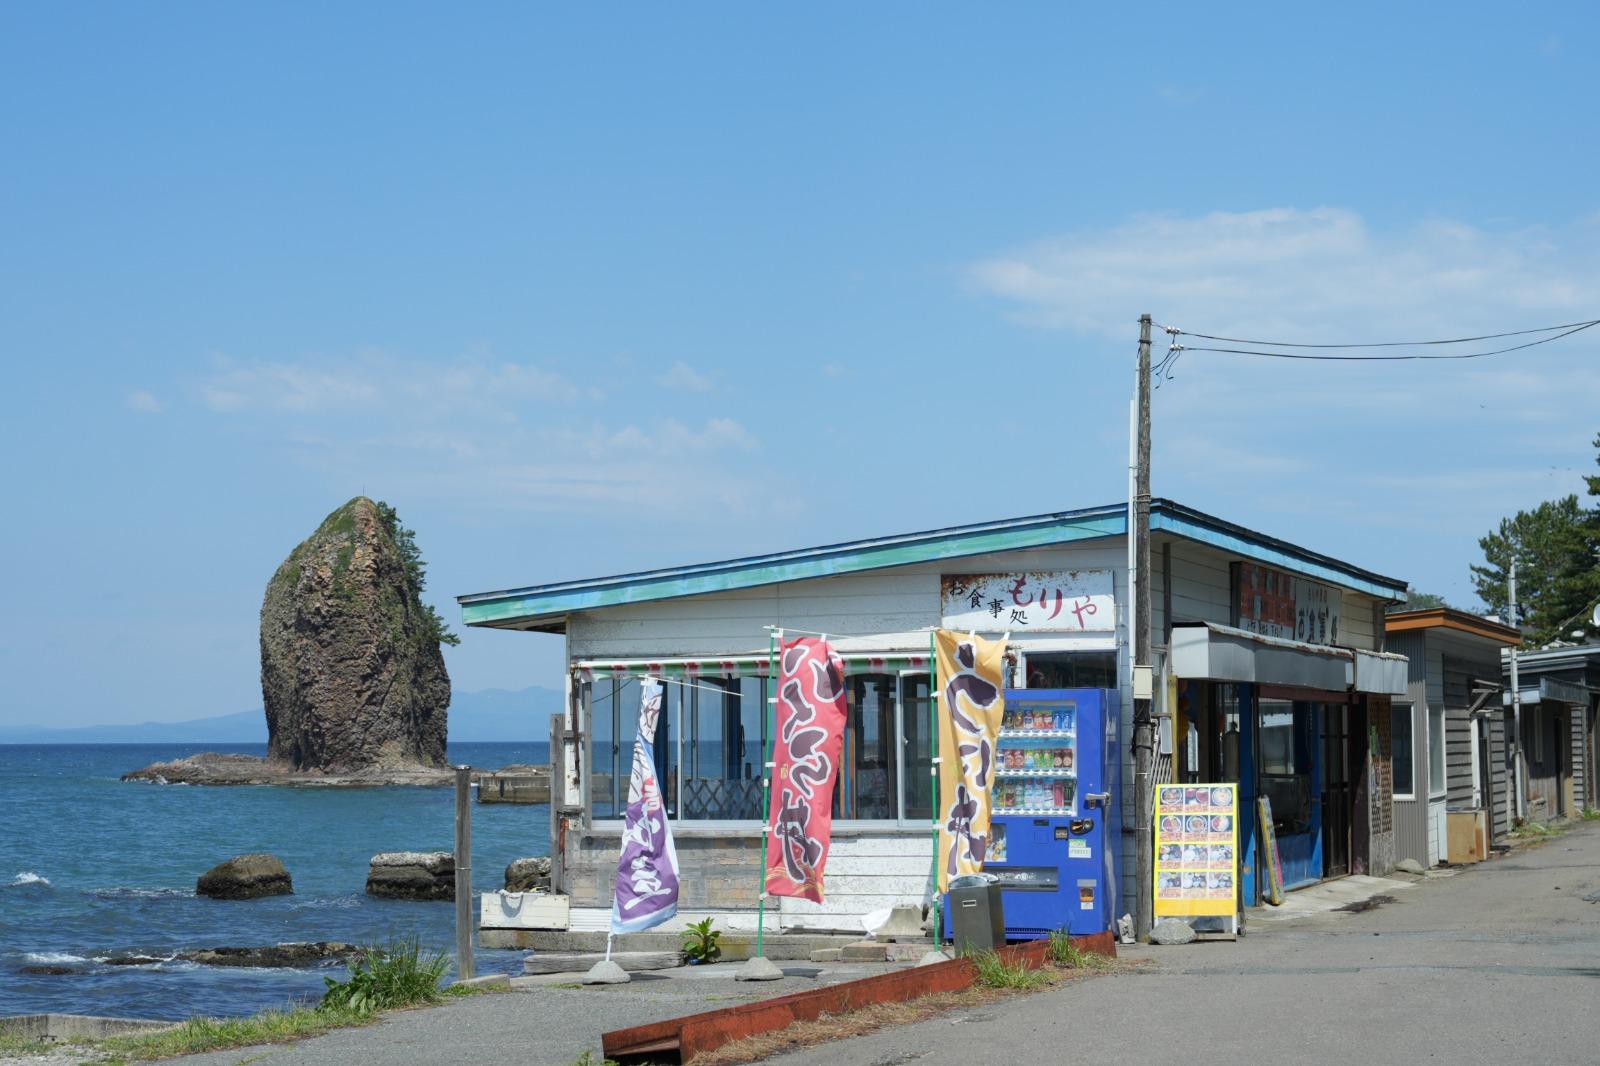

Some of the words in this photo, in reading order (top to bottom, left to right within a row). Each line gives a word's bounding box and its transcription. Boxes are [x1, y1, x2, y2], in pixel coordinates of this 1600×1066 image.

[949, 579, 1028, 625] お食事処
[1009, 574, 1097, 630] もりや
